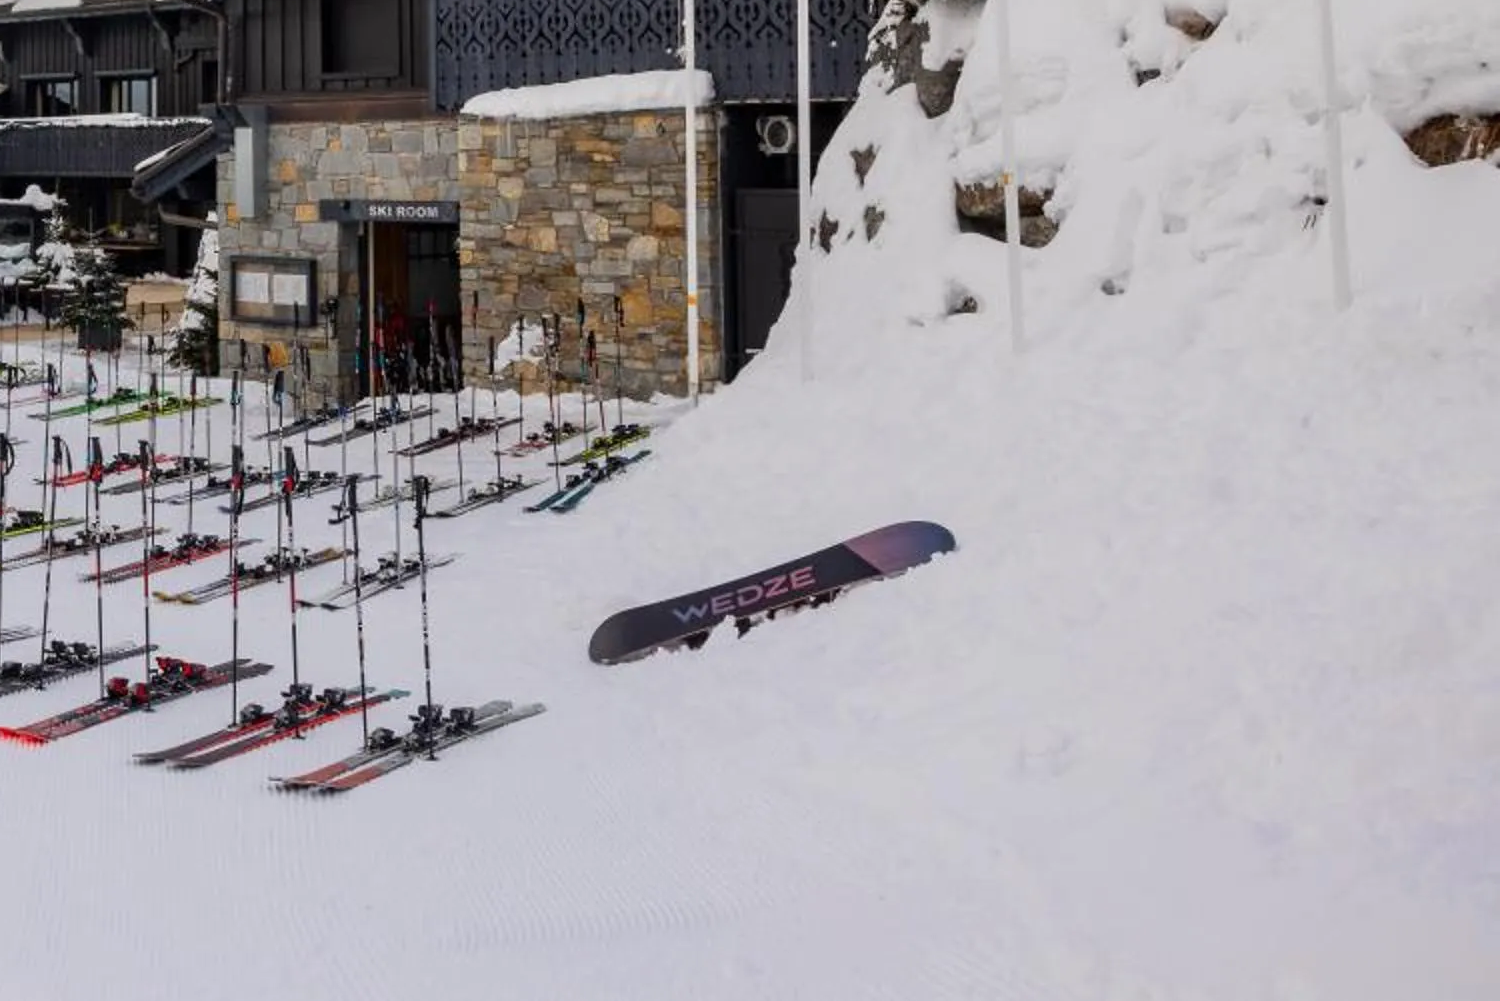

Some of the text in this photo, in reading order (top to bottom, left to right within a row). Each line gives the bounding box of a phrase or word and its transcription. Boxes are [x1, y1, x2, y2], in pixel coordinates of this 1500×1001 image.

[369, 205, 438, 218] SKI ROOM
[673, 565, 817, 623] WEDZE
